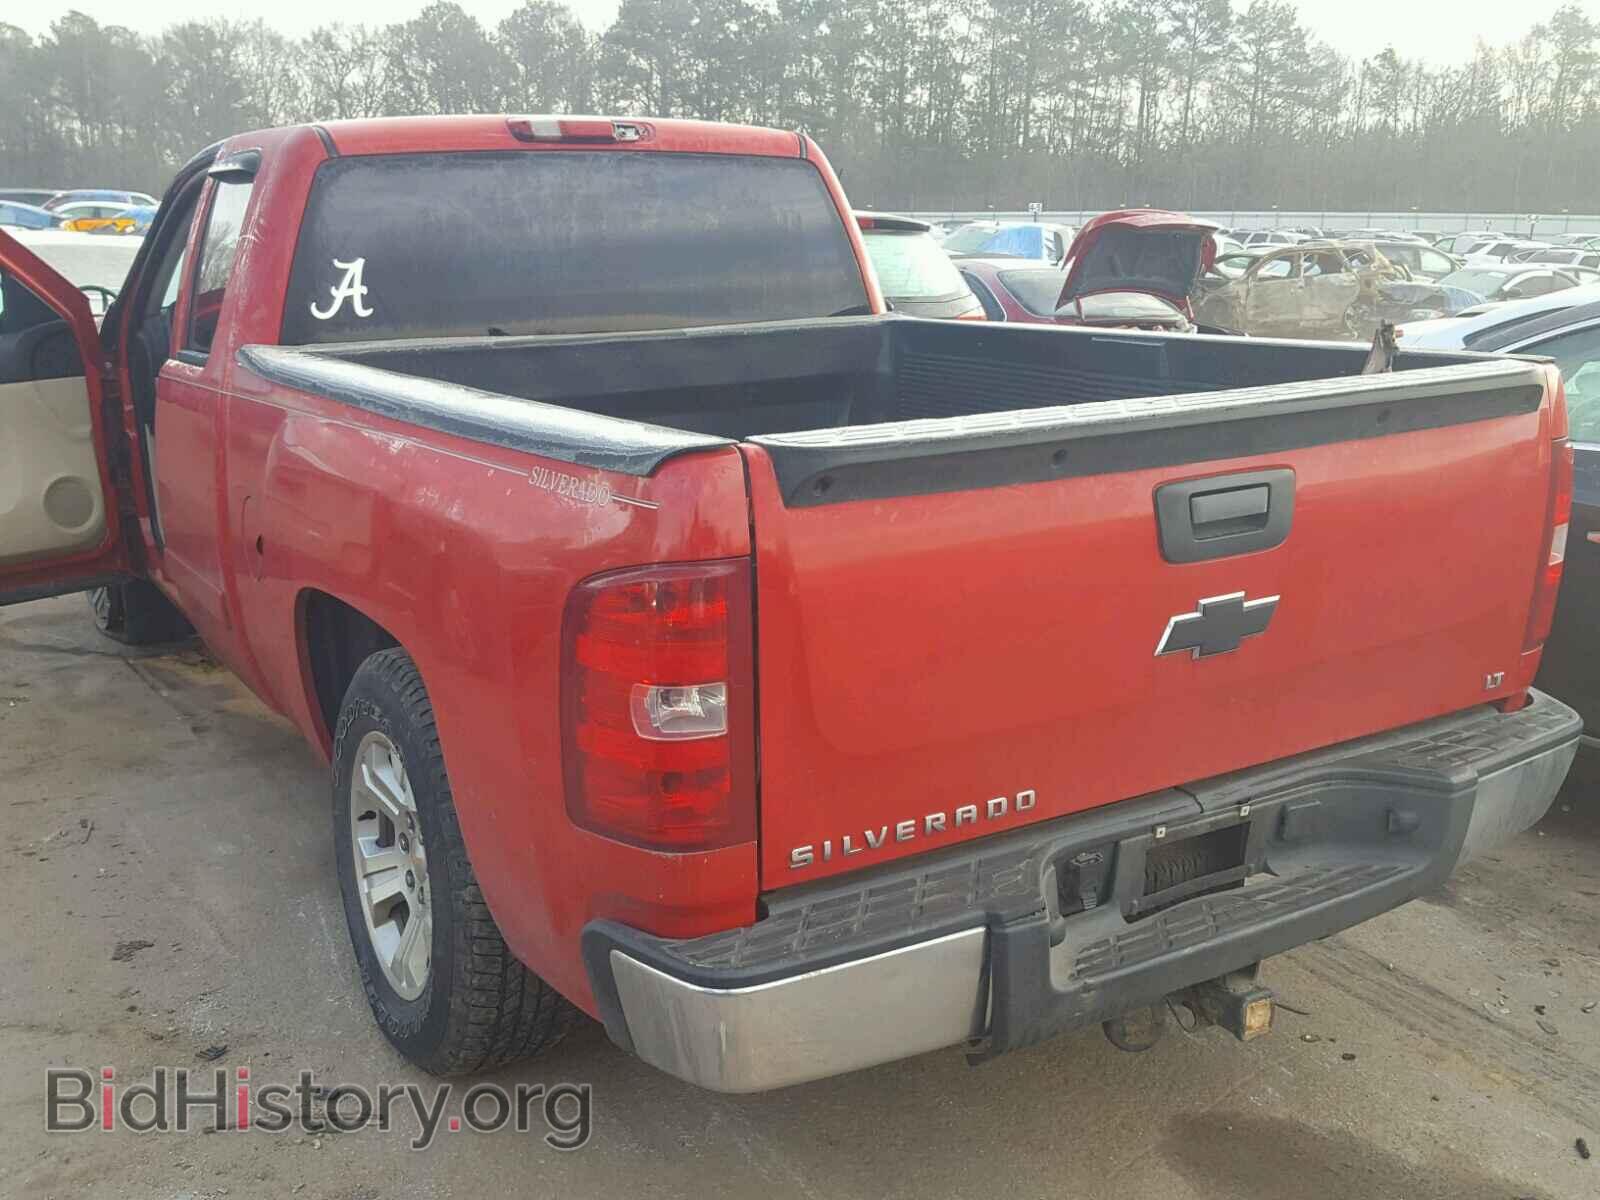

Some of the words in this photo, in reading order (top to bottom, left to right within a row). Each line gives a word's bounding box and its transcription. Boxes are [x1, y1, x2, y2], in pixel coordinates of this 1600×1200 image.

[310, 257, 374, 320] A
[528, 466, 610, 506] SILVERADO
[1485, 671, 1505, 689] LT
[790, 789, 1036, 869] SILVERADO
